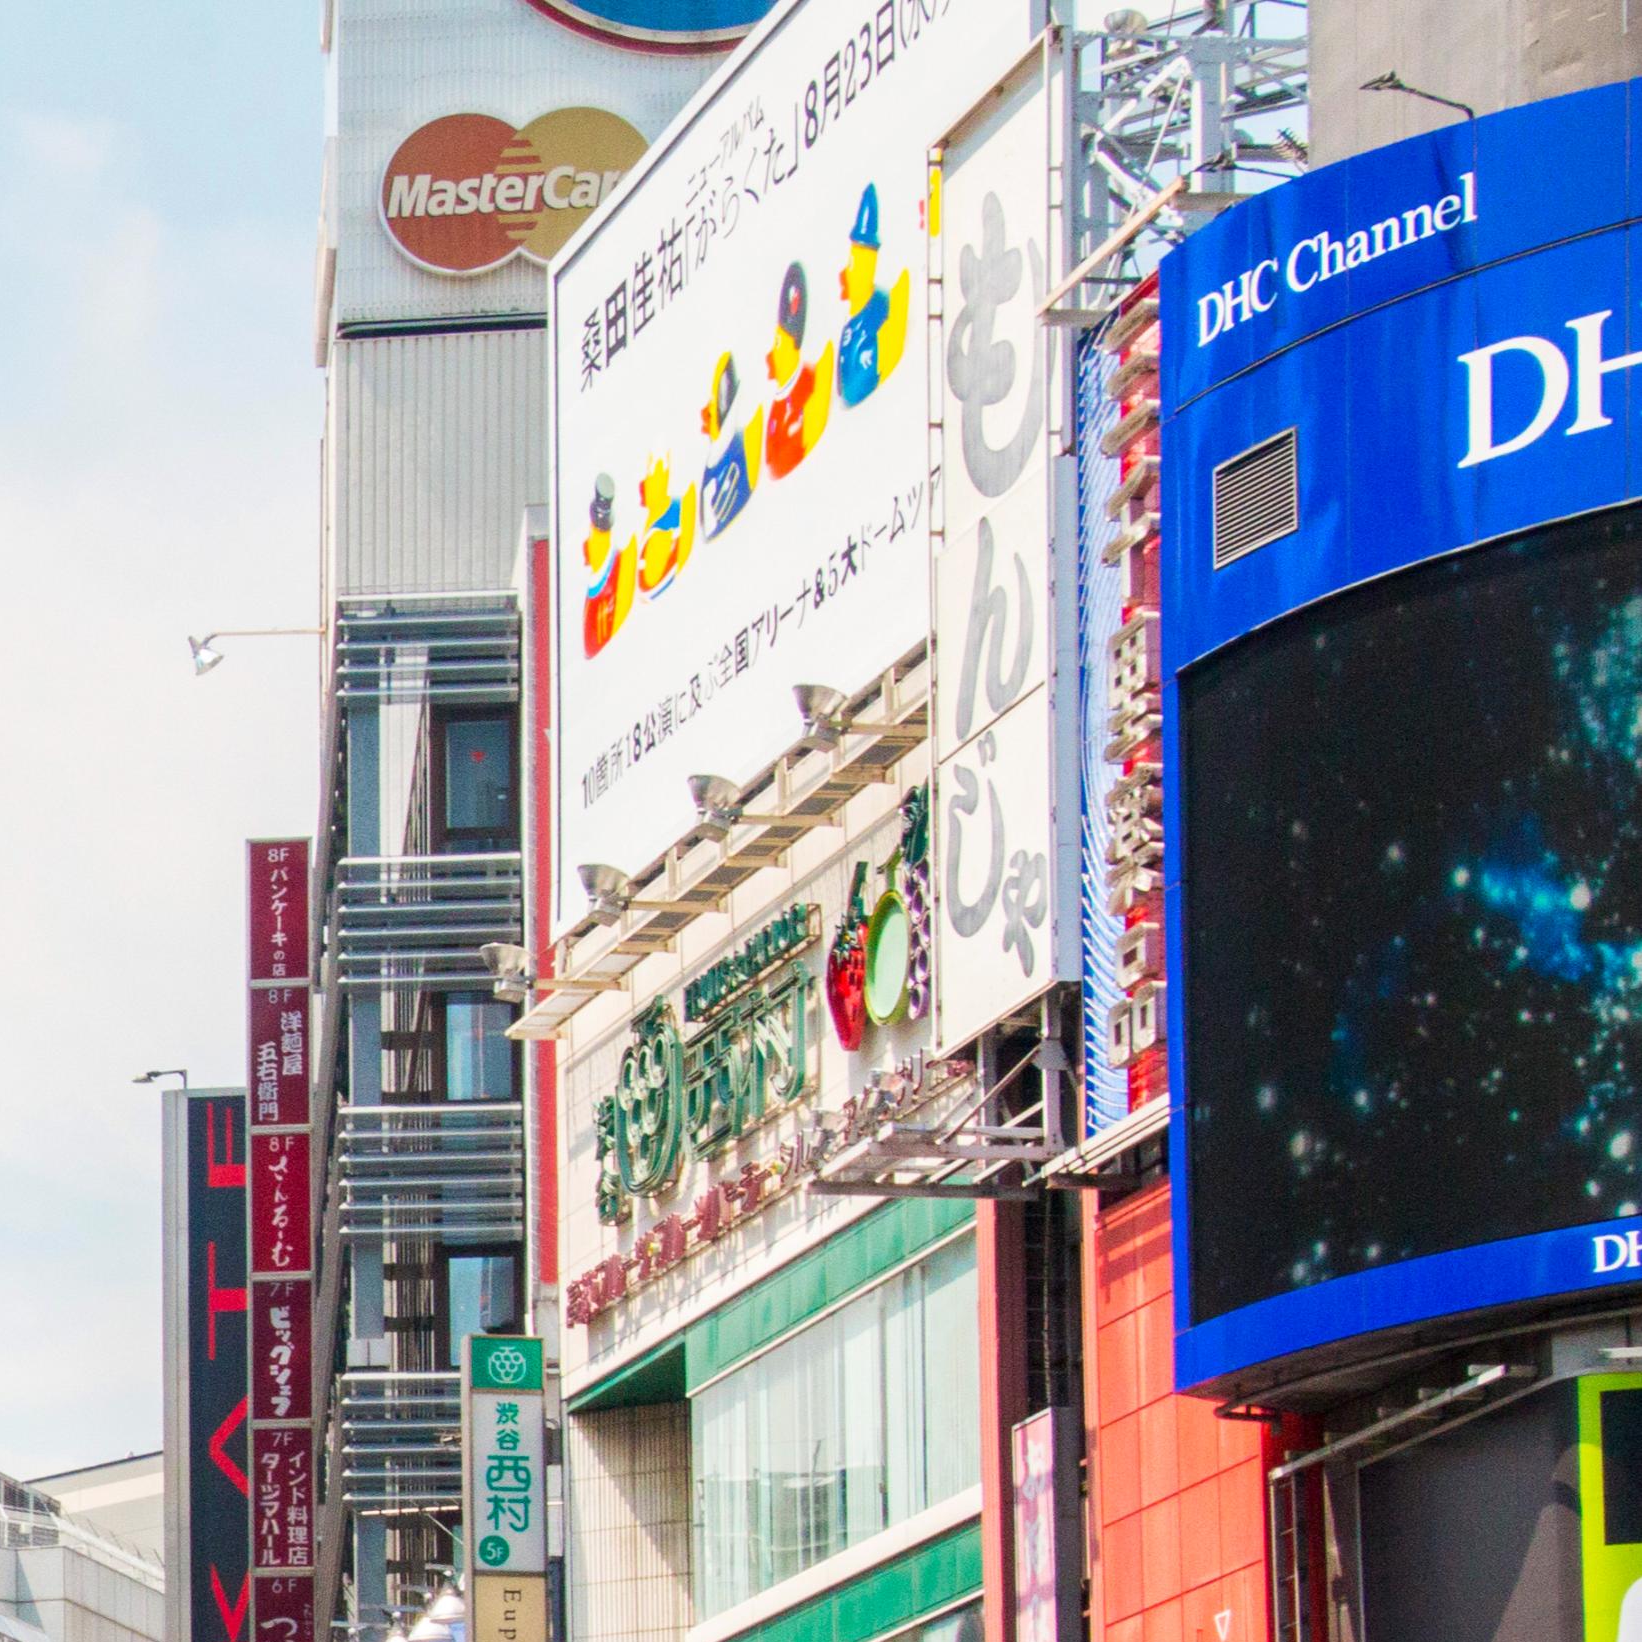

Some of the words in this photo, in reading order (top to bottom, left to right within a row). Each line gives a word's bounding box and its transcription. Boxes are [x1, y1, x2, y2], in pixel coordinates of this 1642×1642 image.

[686, 95, 765, 207] ニューアルバム
[1197, 257, 1278, 347] DHC
[1285, 172, 1478, 293] Channel
[946, 190, 1055, 978] もんじゃ
[268, 848, 290, 863] 8F
[268, 867, 288, 977] パンケーキの店
[268, 989, 293, 1004] 8F
[257, 1041, 279, 1122] 五右衛門
[269, 1136, 295, 1153] 8F
[269, 1281, 296, 1298] 7F
[271, 1432, 295, 1448] 7F
[485, 1401, 532, 1534] 渋谷西村
[260, 1453, 282, 1567] タージマハール
[287, 1452, 310, 1567] インド料理店
[271, 1578, 297, 1593] 6F
[485, 1540, 505, 1561] 5F
